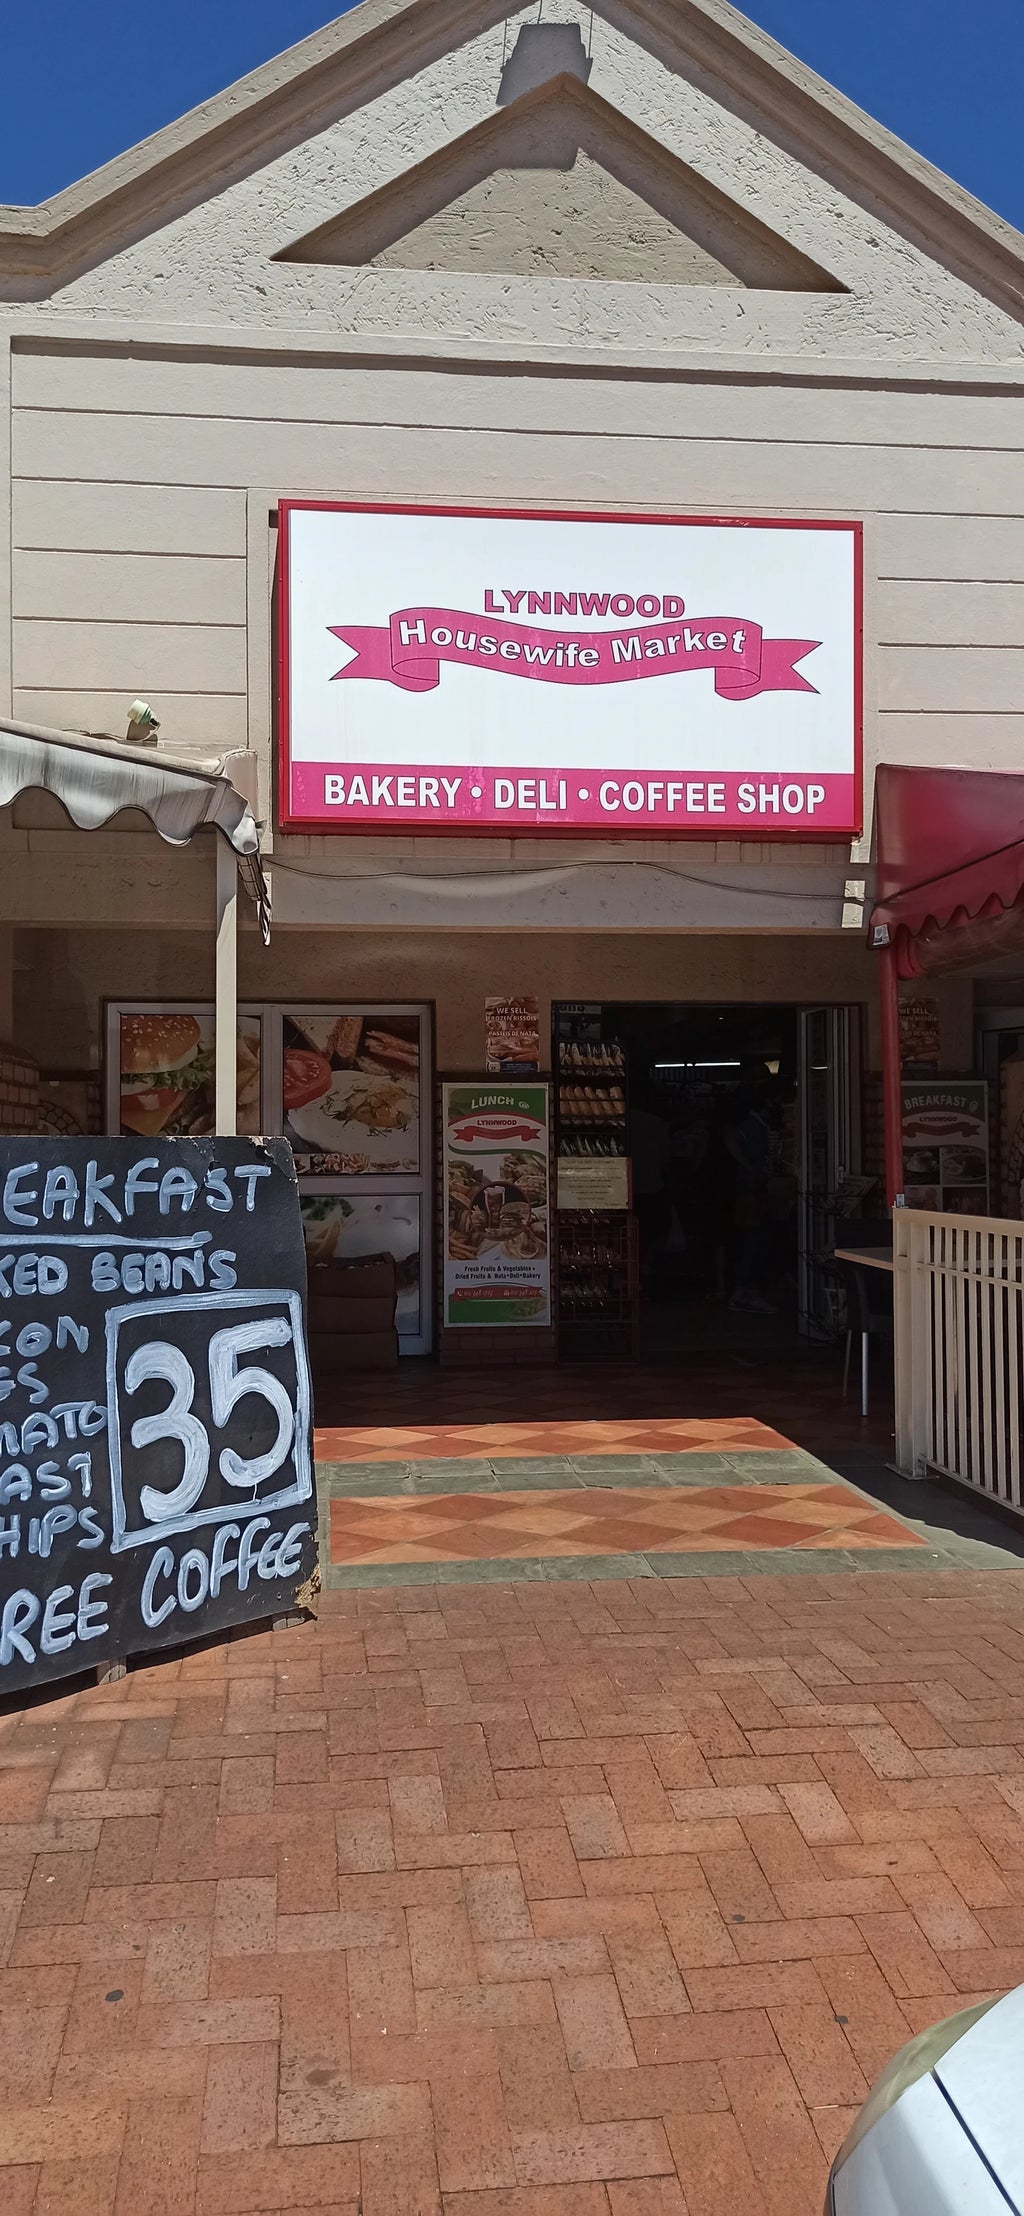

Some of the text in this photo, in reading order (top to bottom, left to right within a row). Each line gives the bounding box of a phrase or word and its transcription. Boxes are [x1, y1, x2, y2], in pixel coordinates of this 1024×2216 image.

[484, 589, 686, 618] LYNNWOOD
[399, 618, 747, 668] Housewife Market
[324, 774, 825, 814] BAKERY DELI COFFEE SHOP
[471, 1096, 514, 1109] LUNCH
[904, 1095, 968, 1110] BREAKFAST
[3, 1158, 272, 1228] EAKFAST
[91, 1250, 237, 1295] BEANS
[125, 1317, 293, 1523] 35
[0, 1504, 105, 1559] HIPS
[141, 1517, 311, 1629] COFFEE
